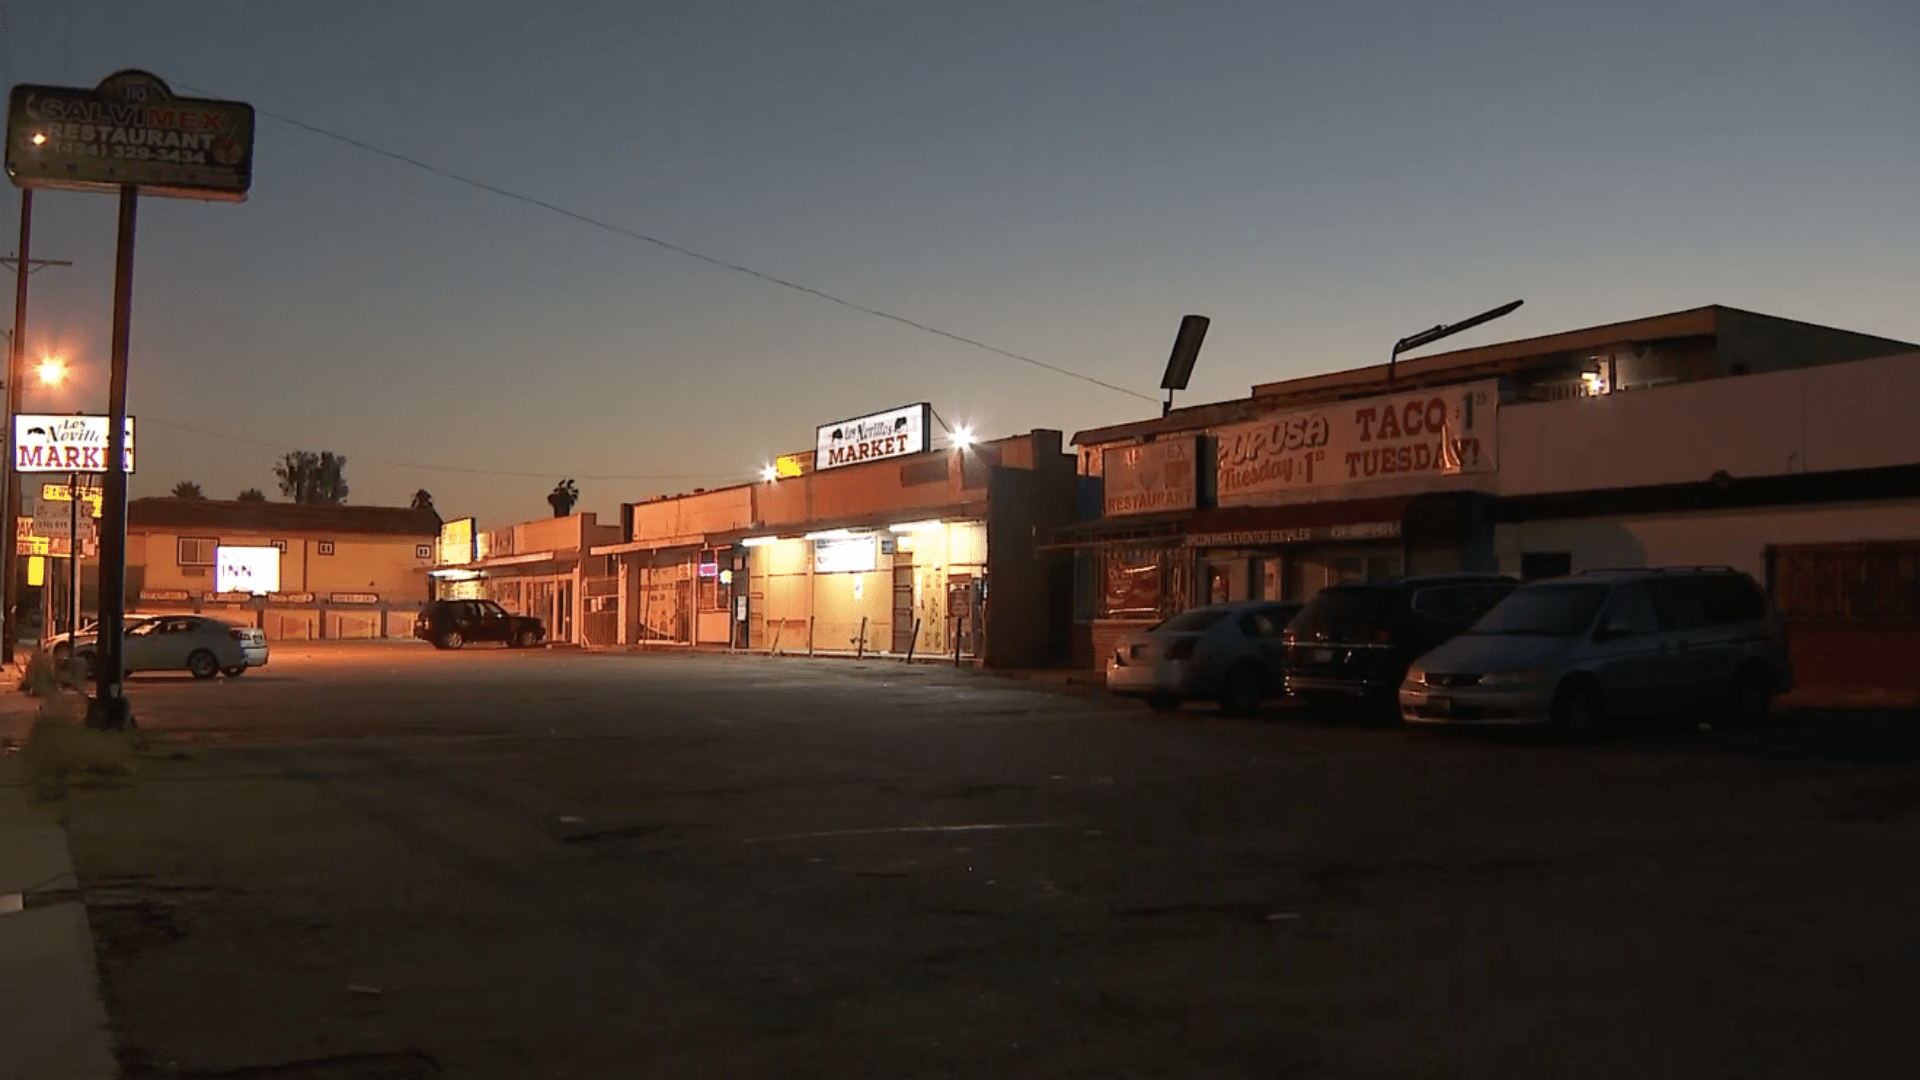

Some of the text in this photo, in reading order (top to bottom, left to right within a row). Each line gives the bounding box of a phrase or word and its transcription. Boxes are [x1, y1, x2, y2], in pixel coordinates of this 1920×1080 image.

[47, 121, 216, 149] RESTAURANT
[113, 147, 205, 164] 329-3434
[64, 419, 86, 430] Los
[1356, 397, 1447, 443] TACO
[828, 434, 908, 465] MARKET
[1218, 413, 1329, 468] PUPUSA
[1220, 458, 1293, 491] Tuesday
[1108, 488, 1192, 511] RESTAURANT
[221, 564, 253, 578] INN
